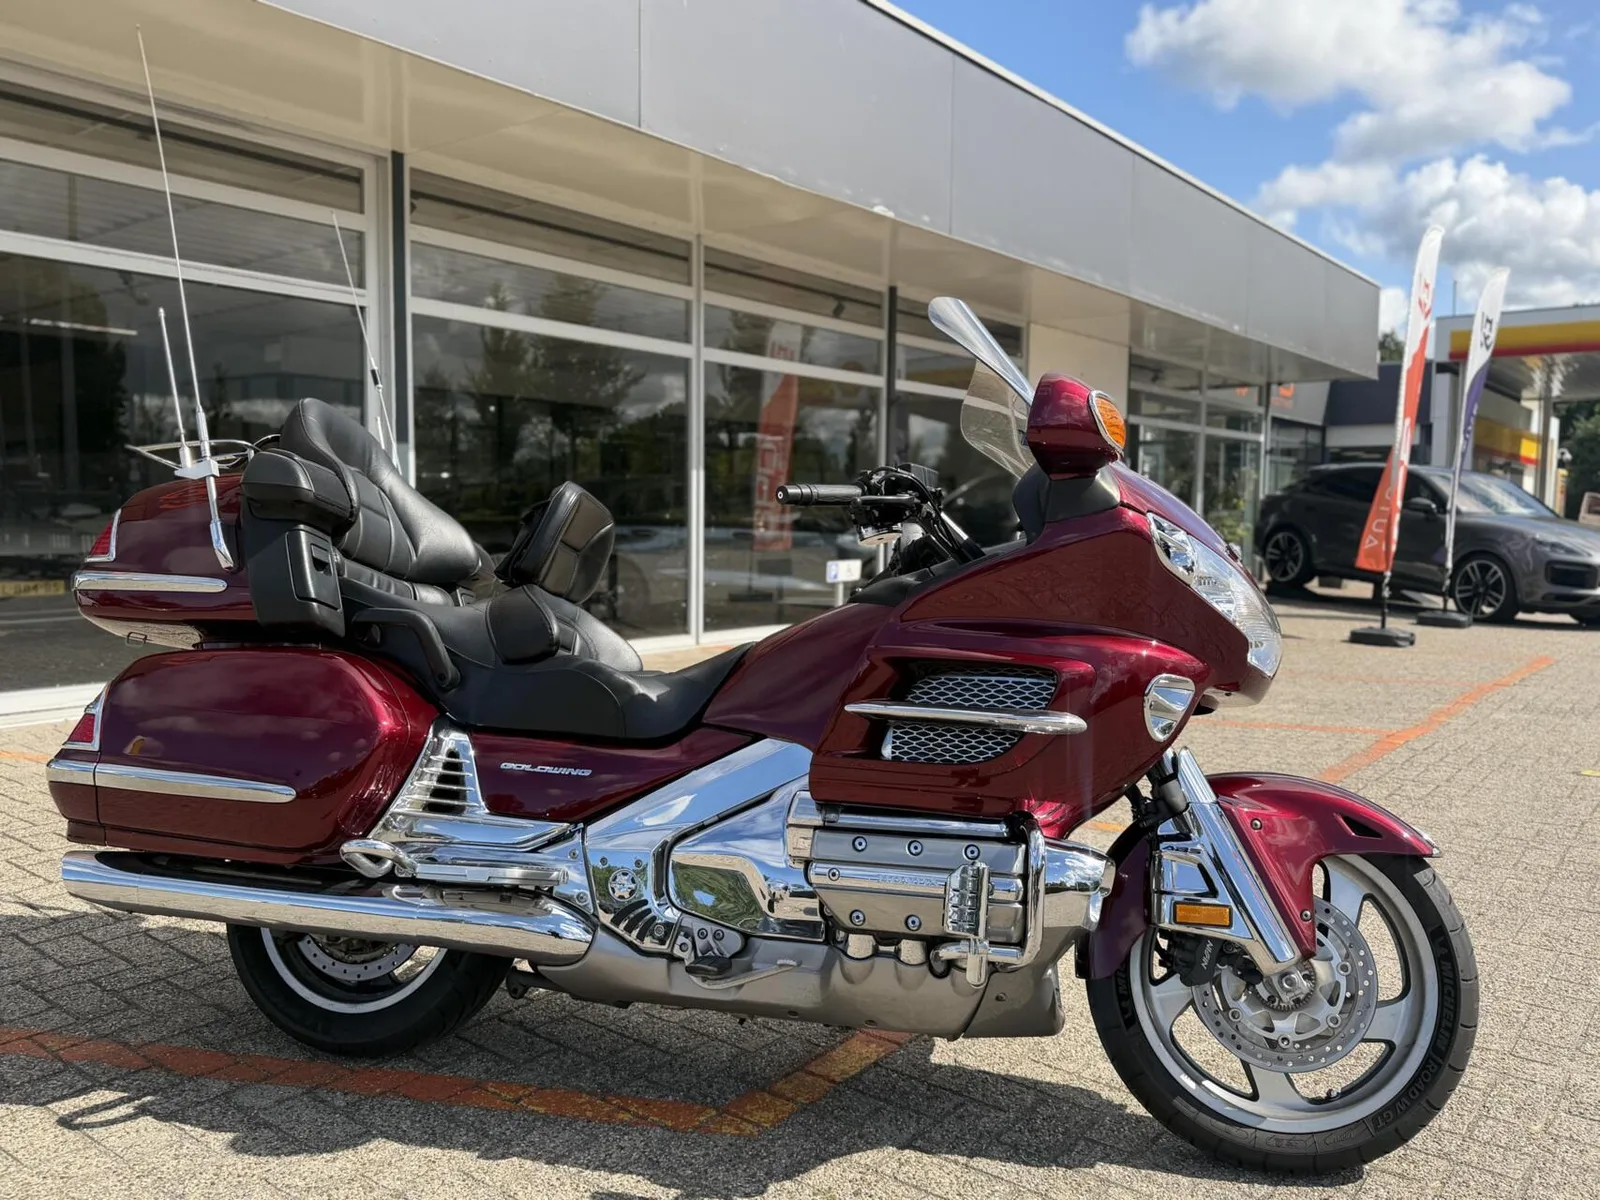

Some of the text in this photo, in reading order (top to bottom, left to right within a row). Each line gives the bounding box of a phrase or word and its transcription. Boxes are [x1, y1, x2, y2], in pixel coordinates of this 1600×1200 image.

[500, 762, 592, 776] GOLDWING
[1437, 960, 1455, 1051] MICHELIN
[1408, 1059, 1438, 1100] ROAD
[1375, 1110, 1393, 1128] GT
